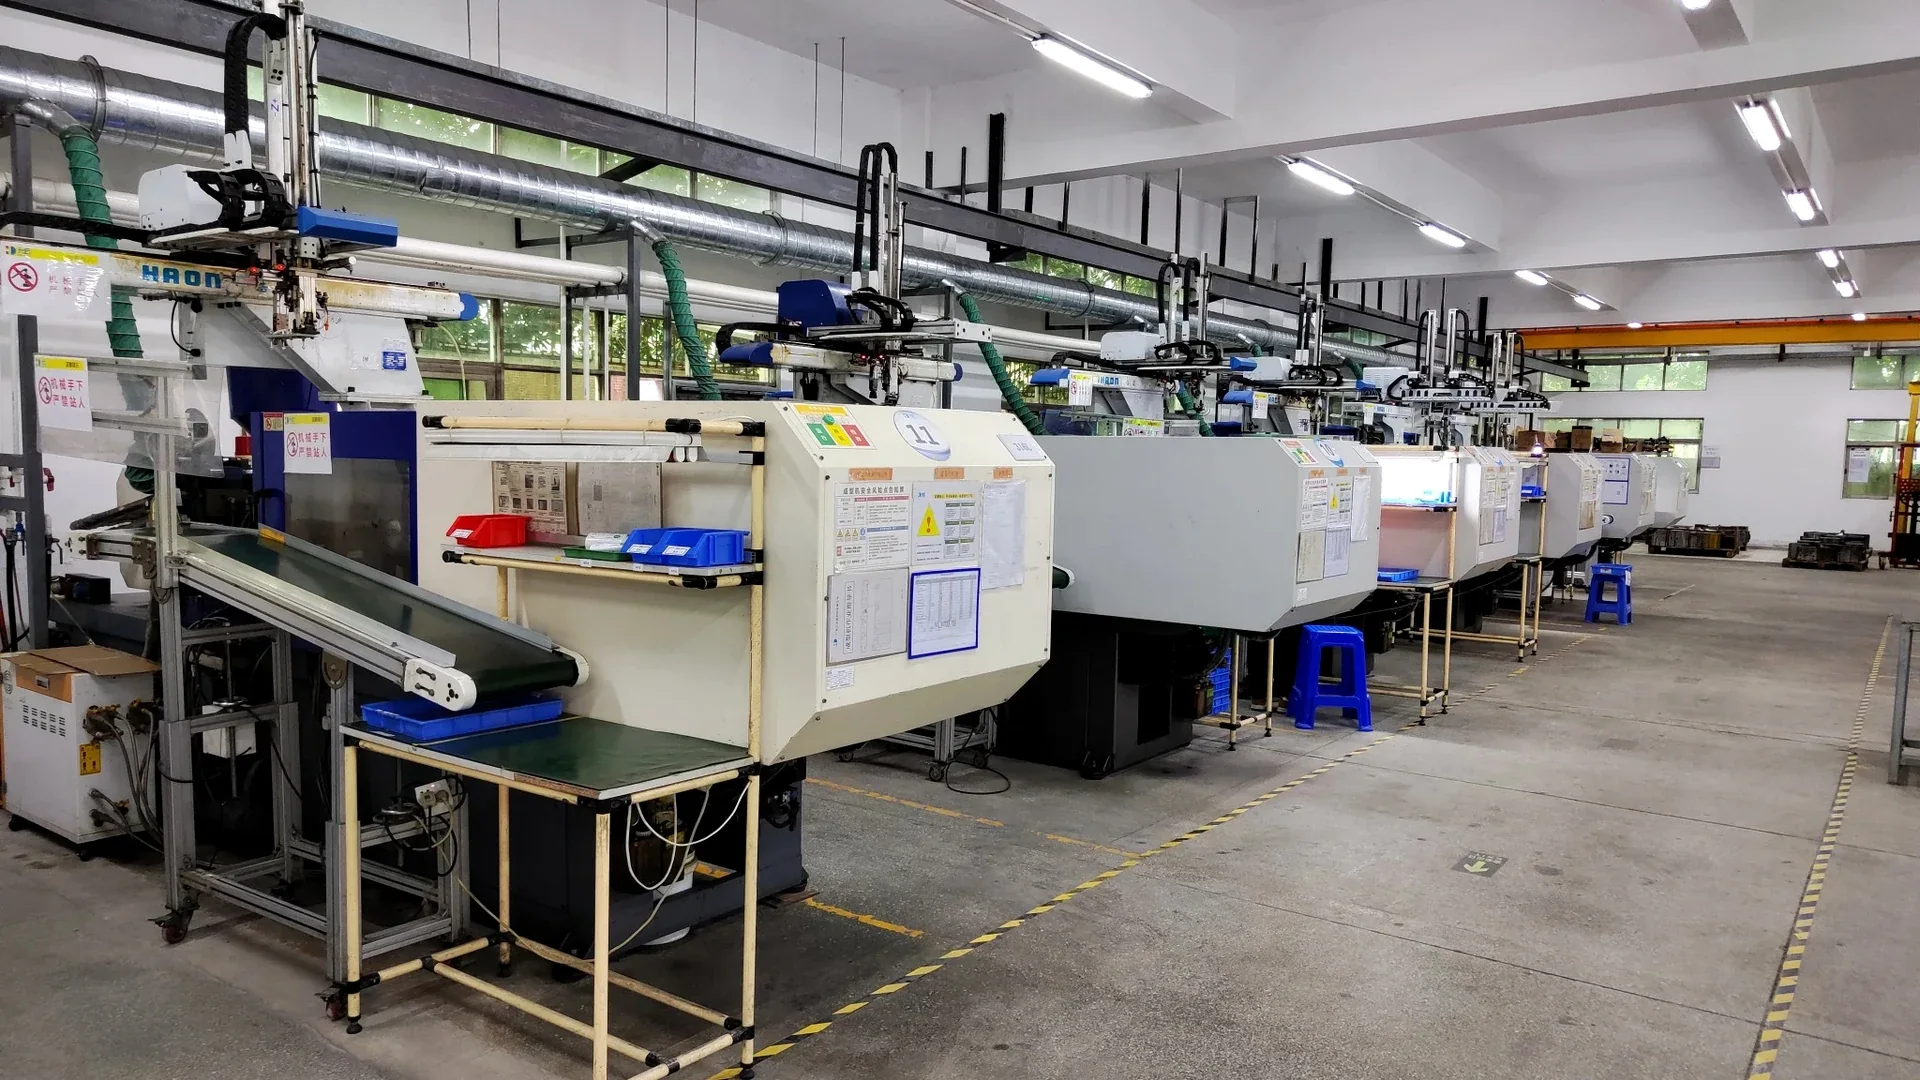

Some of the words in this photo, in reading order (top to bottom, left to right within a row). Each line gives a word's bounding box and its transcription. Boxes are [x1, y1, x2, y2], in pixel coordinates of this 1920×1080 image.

[51, 378, 83, 391] 机械手下
[53, 394, 85, 408] 严禁站人
[298, 432, 326, 443] 机械手下
[906, 424, 940, 445] 11
[299, 446, 327, 457] 严禁站人
